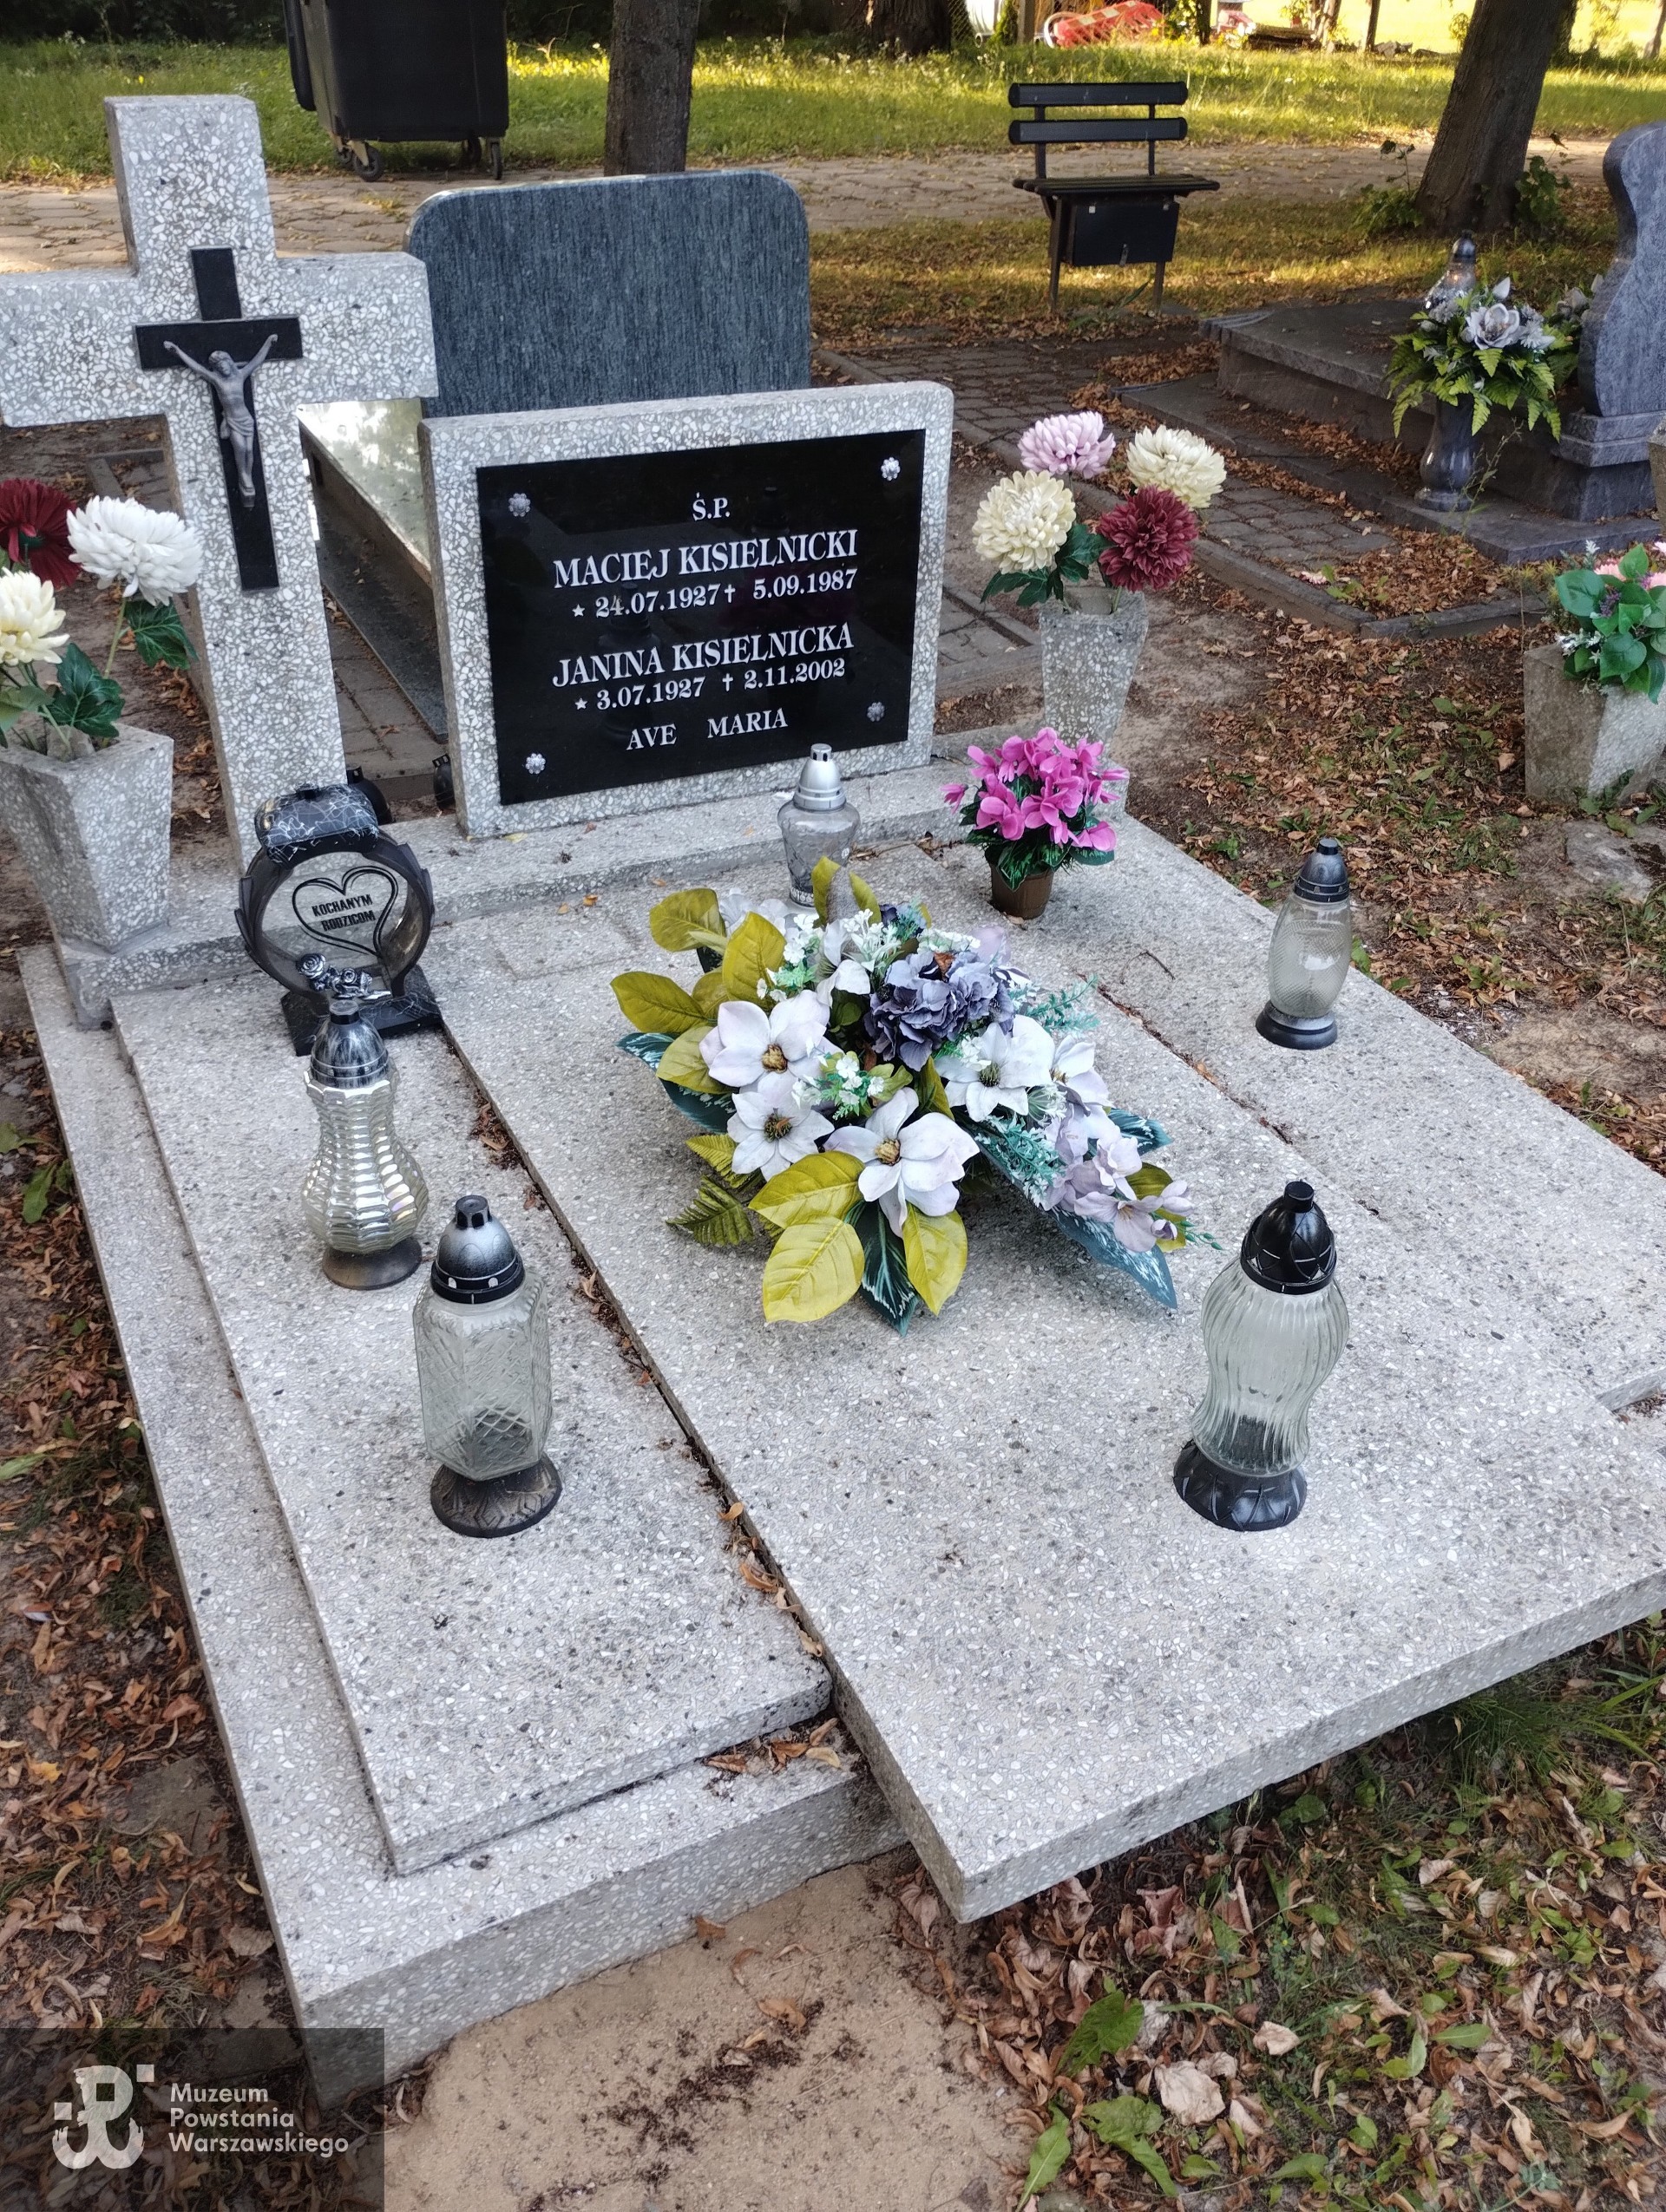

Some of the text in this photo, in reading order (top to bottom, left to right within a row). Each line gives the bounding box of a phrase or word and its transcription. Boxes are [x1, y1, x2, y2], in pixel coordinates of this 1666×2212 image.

[553, 529, 859, 589] MACIEJ KISIELNICKI
[594, 568, 858, 618] 24.07.1927 5.09.1987
[552, 621, 855, 688] JANINA KISIELNICKA
[596, 658, 846, 710] 3.07.1927 2.11.2002
[626, 708, 789, 751] AVE MARIA
[312, 893, 373, 918] KOCHANYM
[321, 910, 376, 932] RODZICOM
